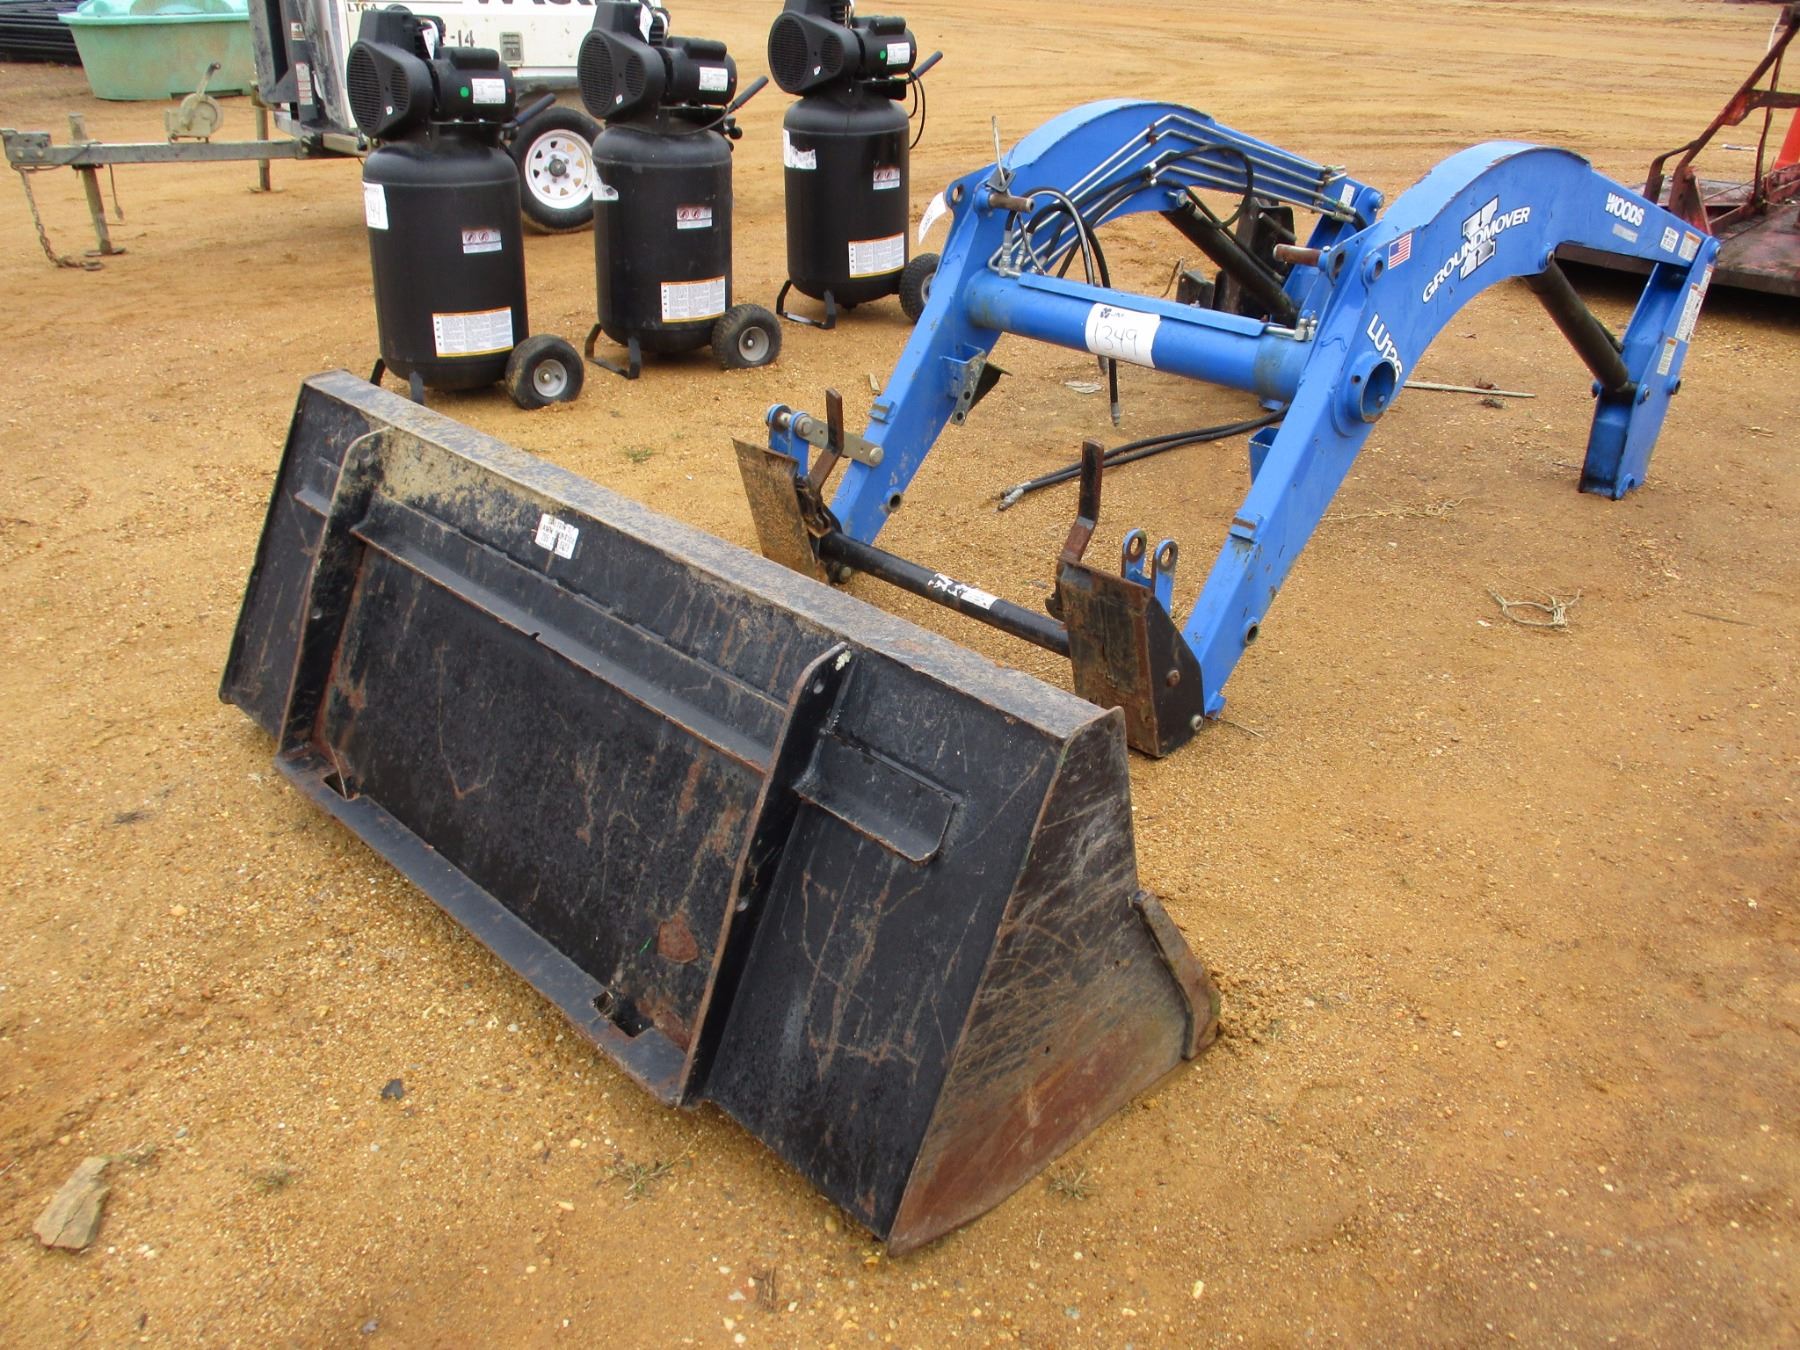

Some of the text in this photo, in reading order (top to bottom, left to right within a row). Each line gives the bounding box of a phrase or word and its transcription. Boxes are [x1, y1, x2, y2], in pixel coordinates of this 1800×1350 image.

[1605, 192, 1645, 227] WOODS
[1423, 207, 1531, 303] GROUNDMOVER
[1094, 322, 1138, 356] 1349
